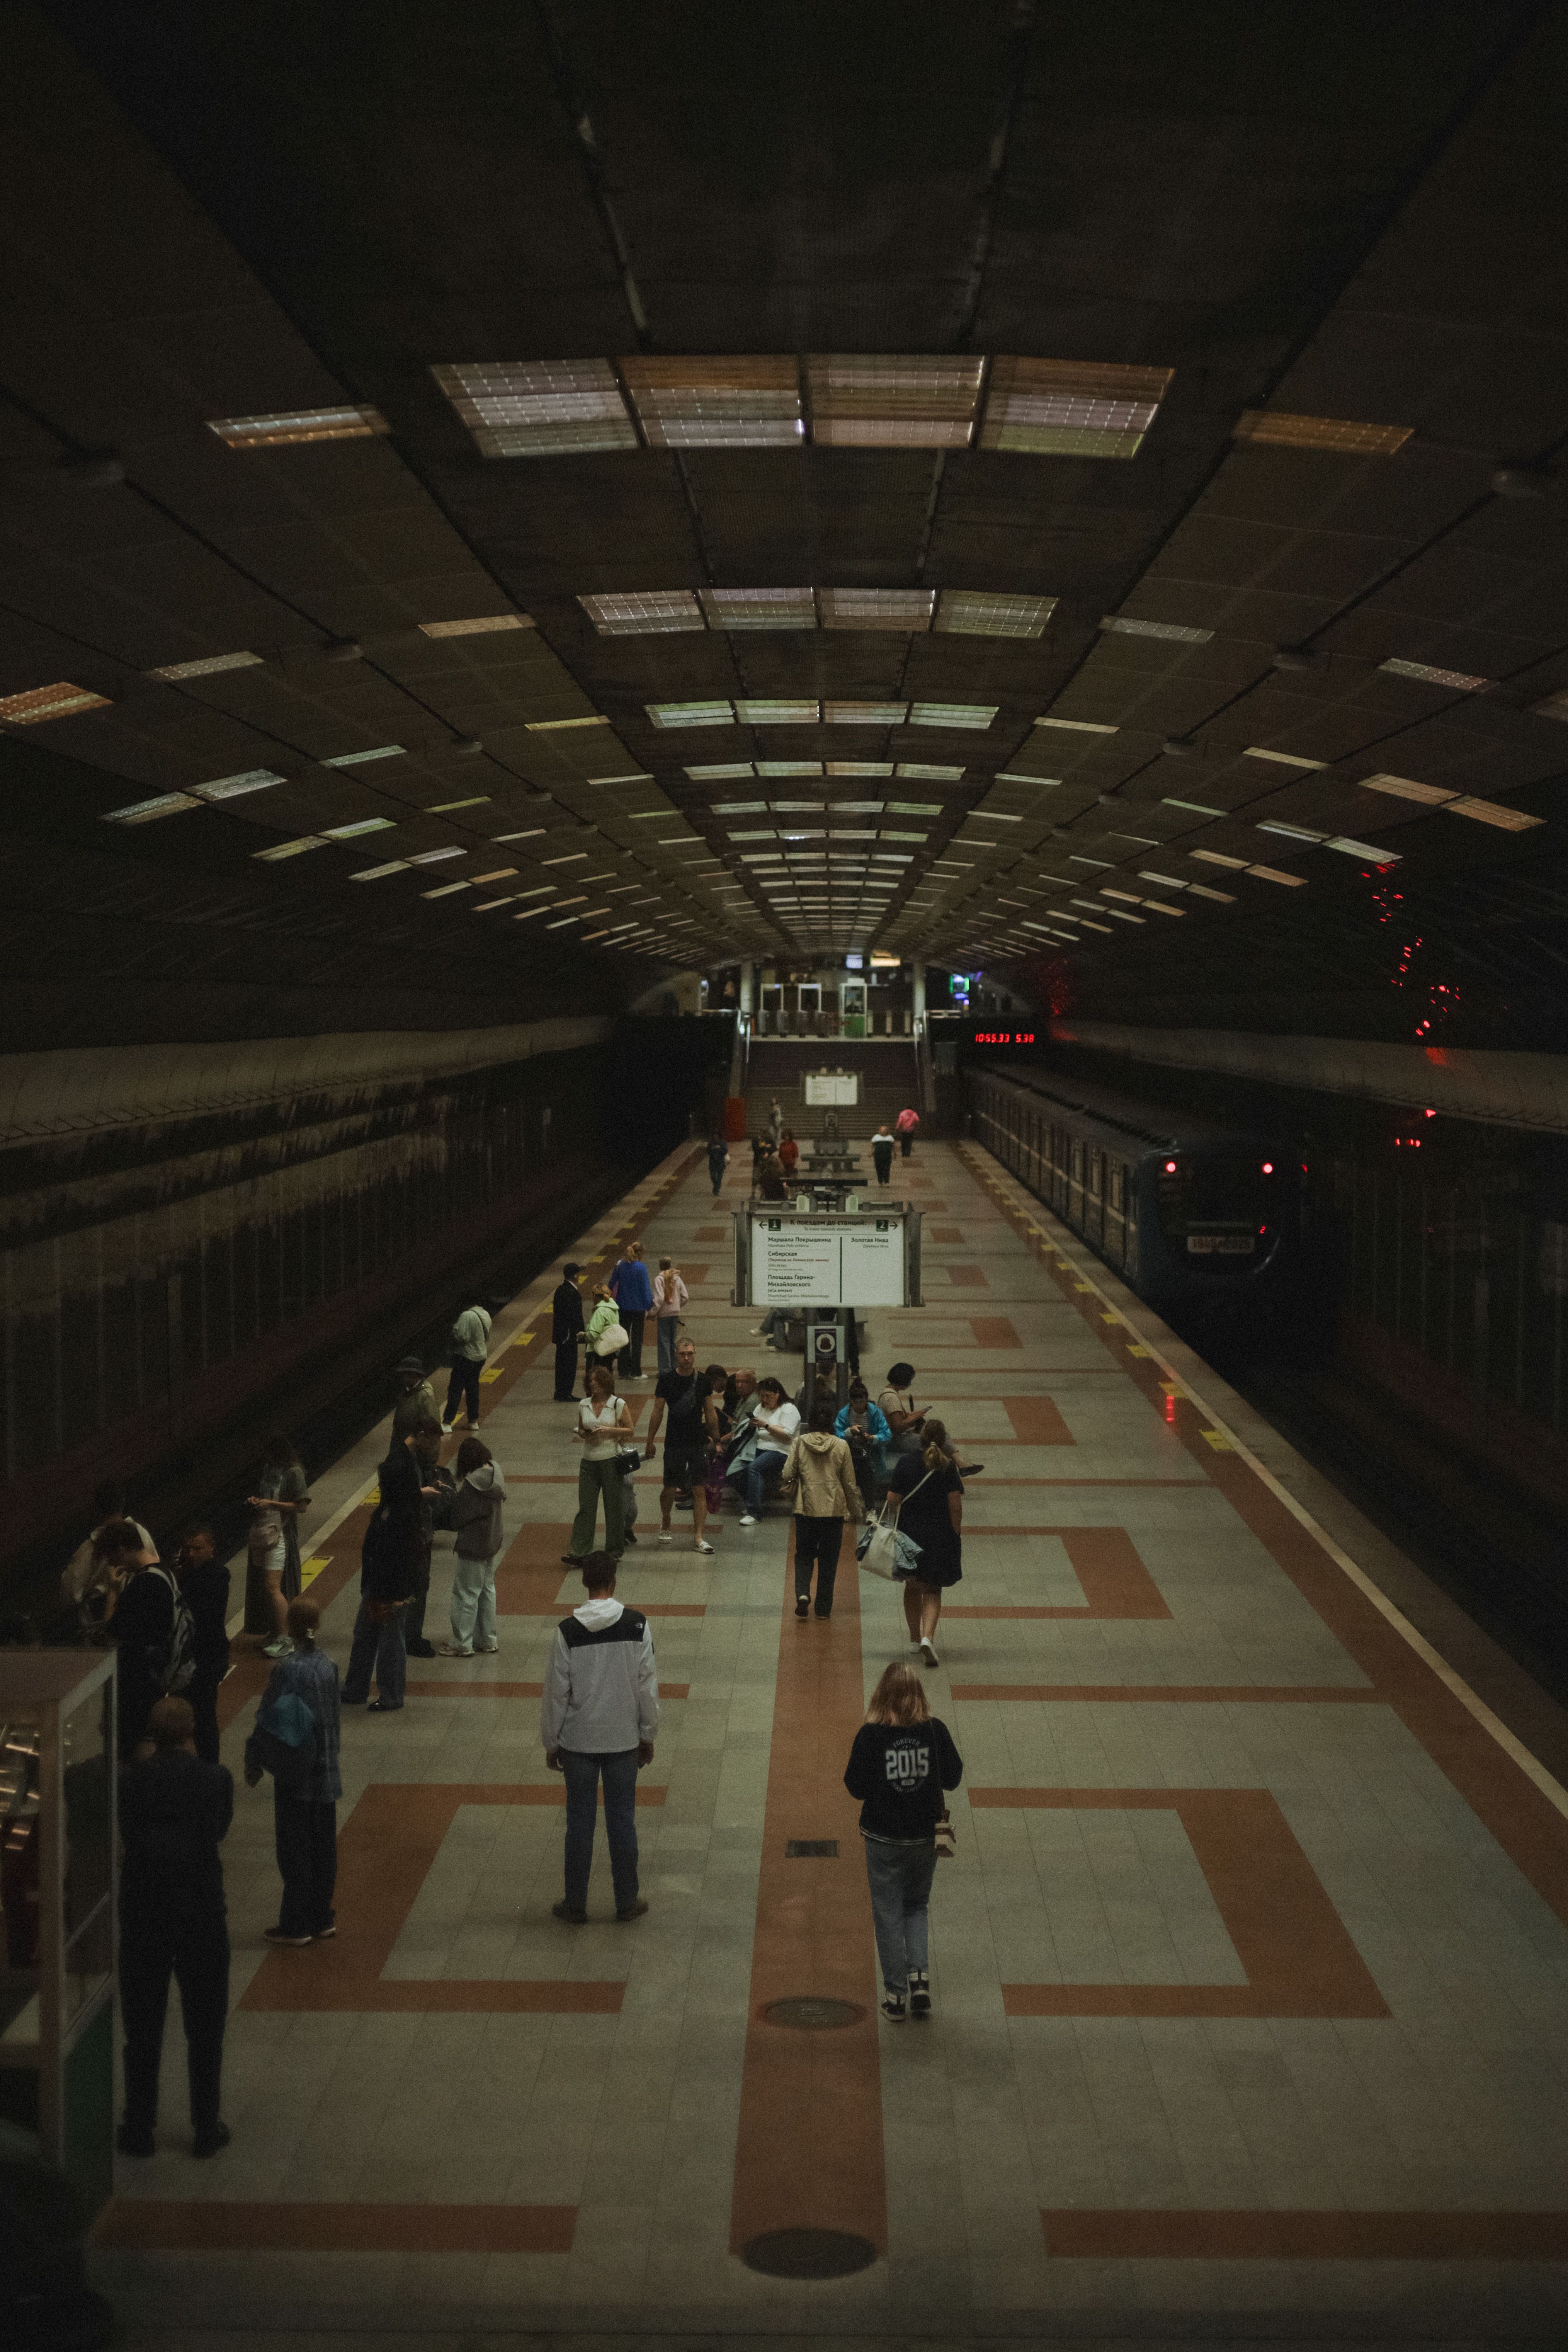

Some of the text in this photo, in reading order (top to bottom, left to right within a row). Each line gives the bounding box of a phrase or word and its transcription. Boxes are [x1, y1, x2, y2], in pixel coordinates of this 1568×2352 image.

[879, 1220, 885, 1229] 2
[893, 1738, 920, 1748] FOREVER
[885, 1747, 929, 1780] 2015
